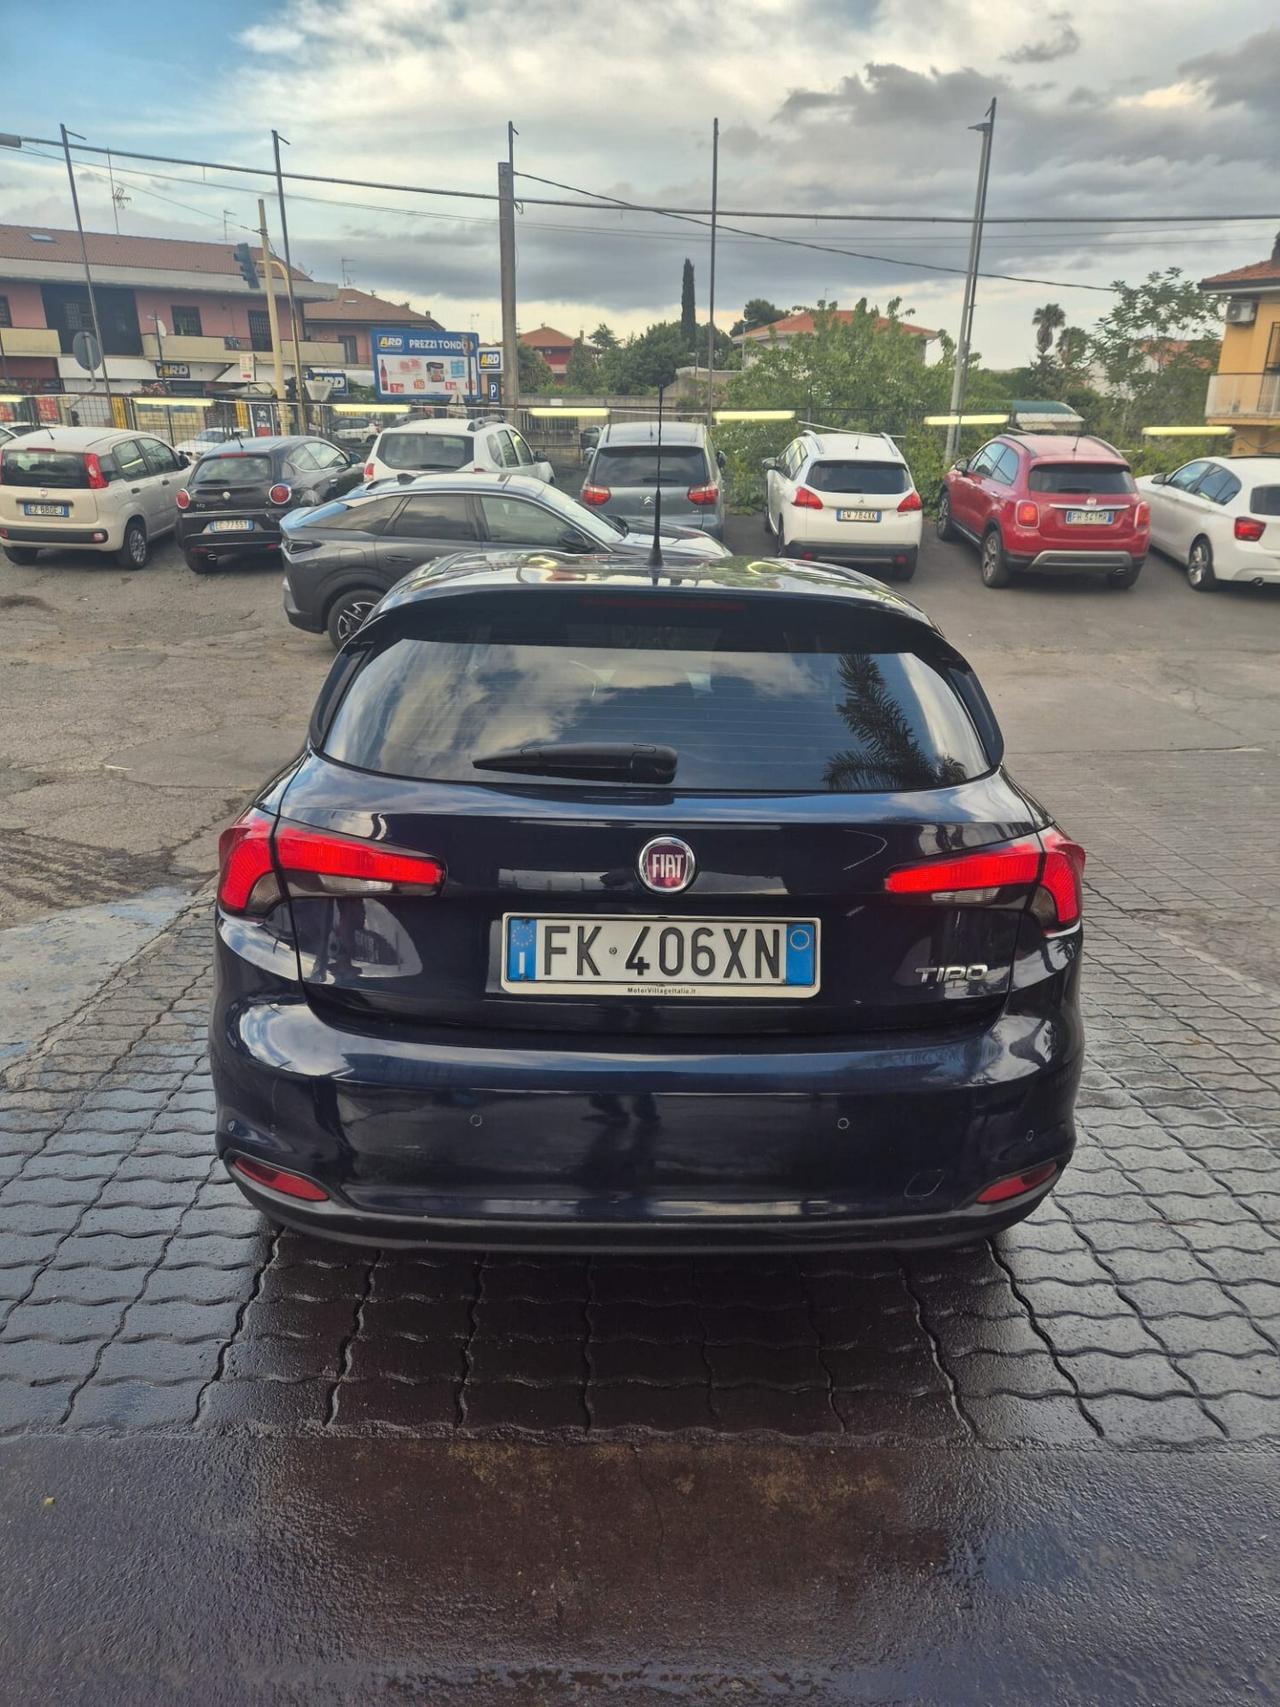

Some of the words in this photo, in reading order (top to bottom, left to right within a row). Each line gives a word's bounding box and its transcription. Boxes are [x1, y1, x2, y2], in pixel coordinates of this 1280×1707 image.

[380, 336, 402, 347] ARD
[409, 339, 437, 349] PREZZI
[481, 353, 500, 367] ARD
[490, 384, 497, 397] P
[652, 853, 684, 878] FIAT
[544, 925, 602, 977] FK
[625, 926, 780, 978] 406XN
[915, 965, 988, 983] TIPO
[627, 987, 696, 995] MotorVillageItalia.it
